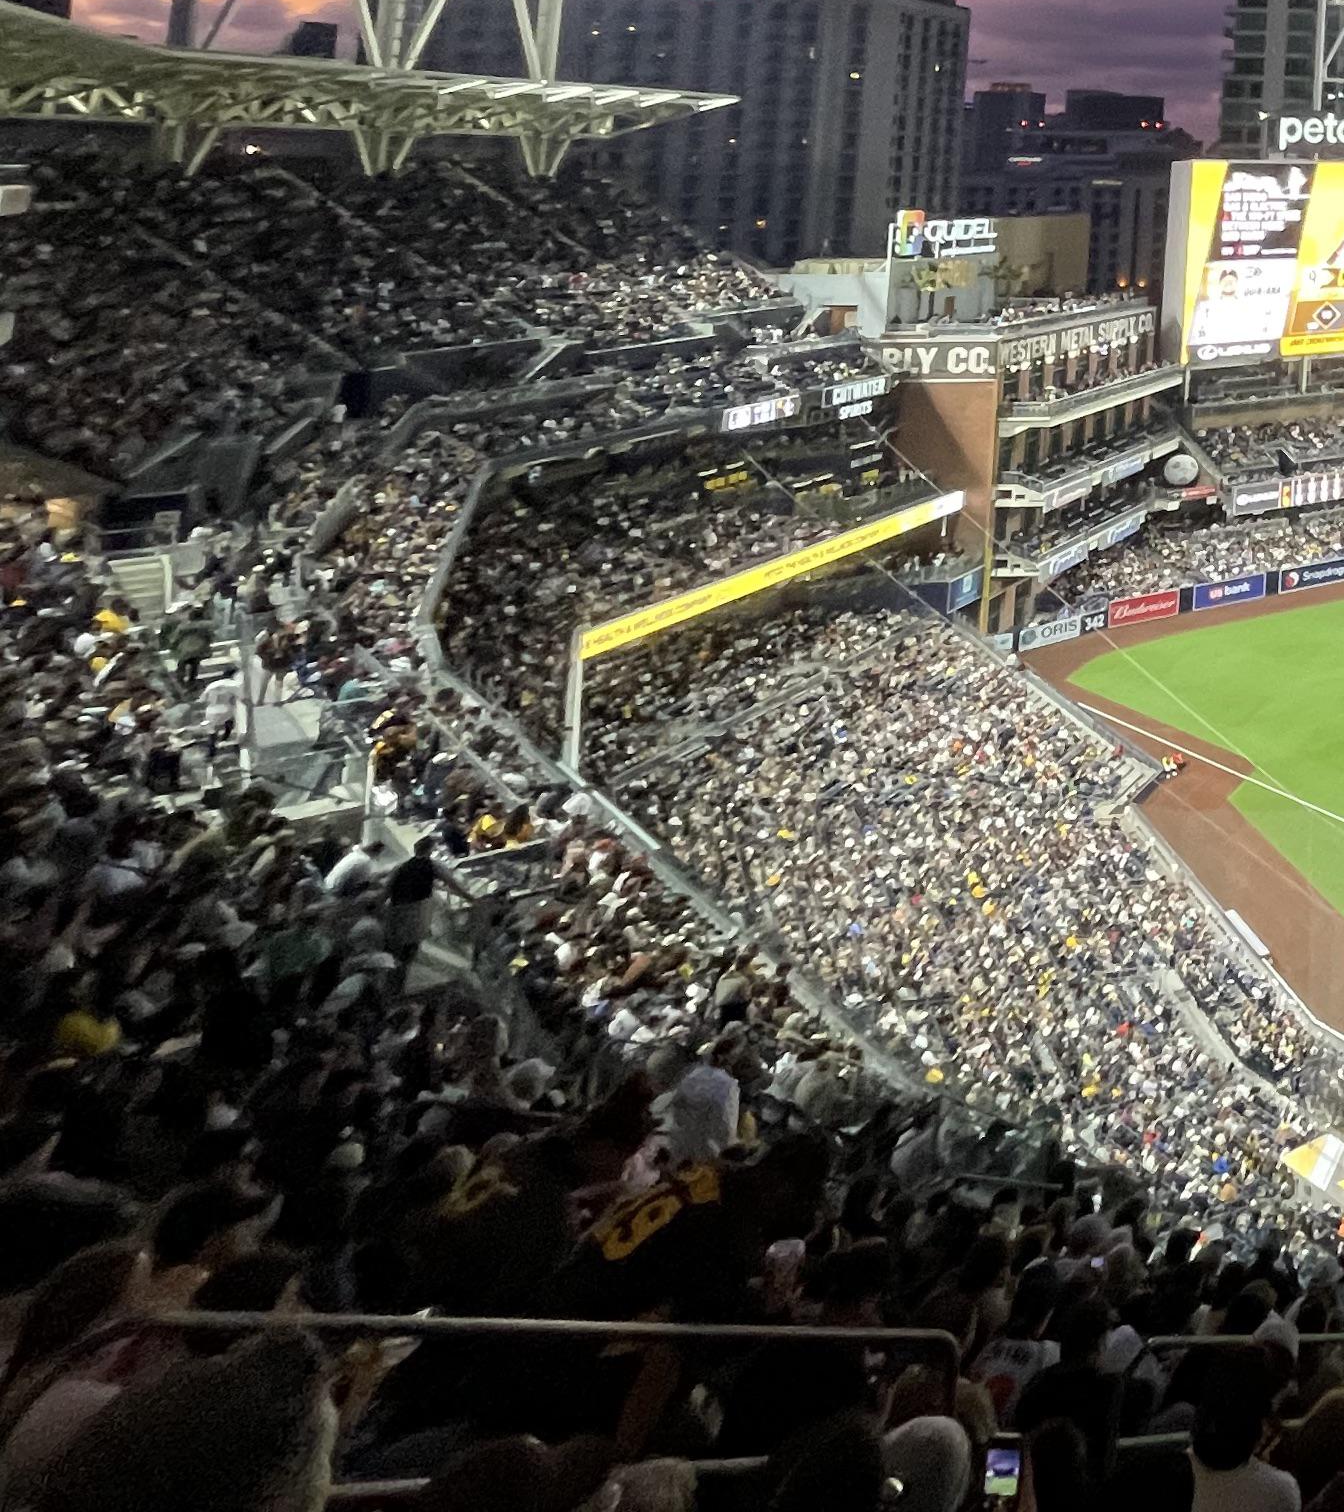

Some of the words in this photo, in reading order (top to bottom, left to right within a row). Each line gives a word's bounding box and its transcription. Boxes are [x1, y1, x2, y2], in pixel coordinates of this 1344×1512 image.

[1002, 333, 1057, 365] WESTERN
[1060, 327, 1095, 353] METAL
[1098, 314, 1137, 341] SUPPLY
[946, 346, 996, 374] CO.
[1224, 582, 1251, 596] bank
[1113, 599, 1177, 620] Budweiser
[1041, 619, 1078, 638] ORIS
